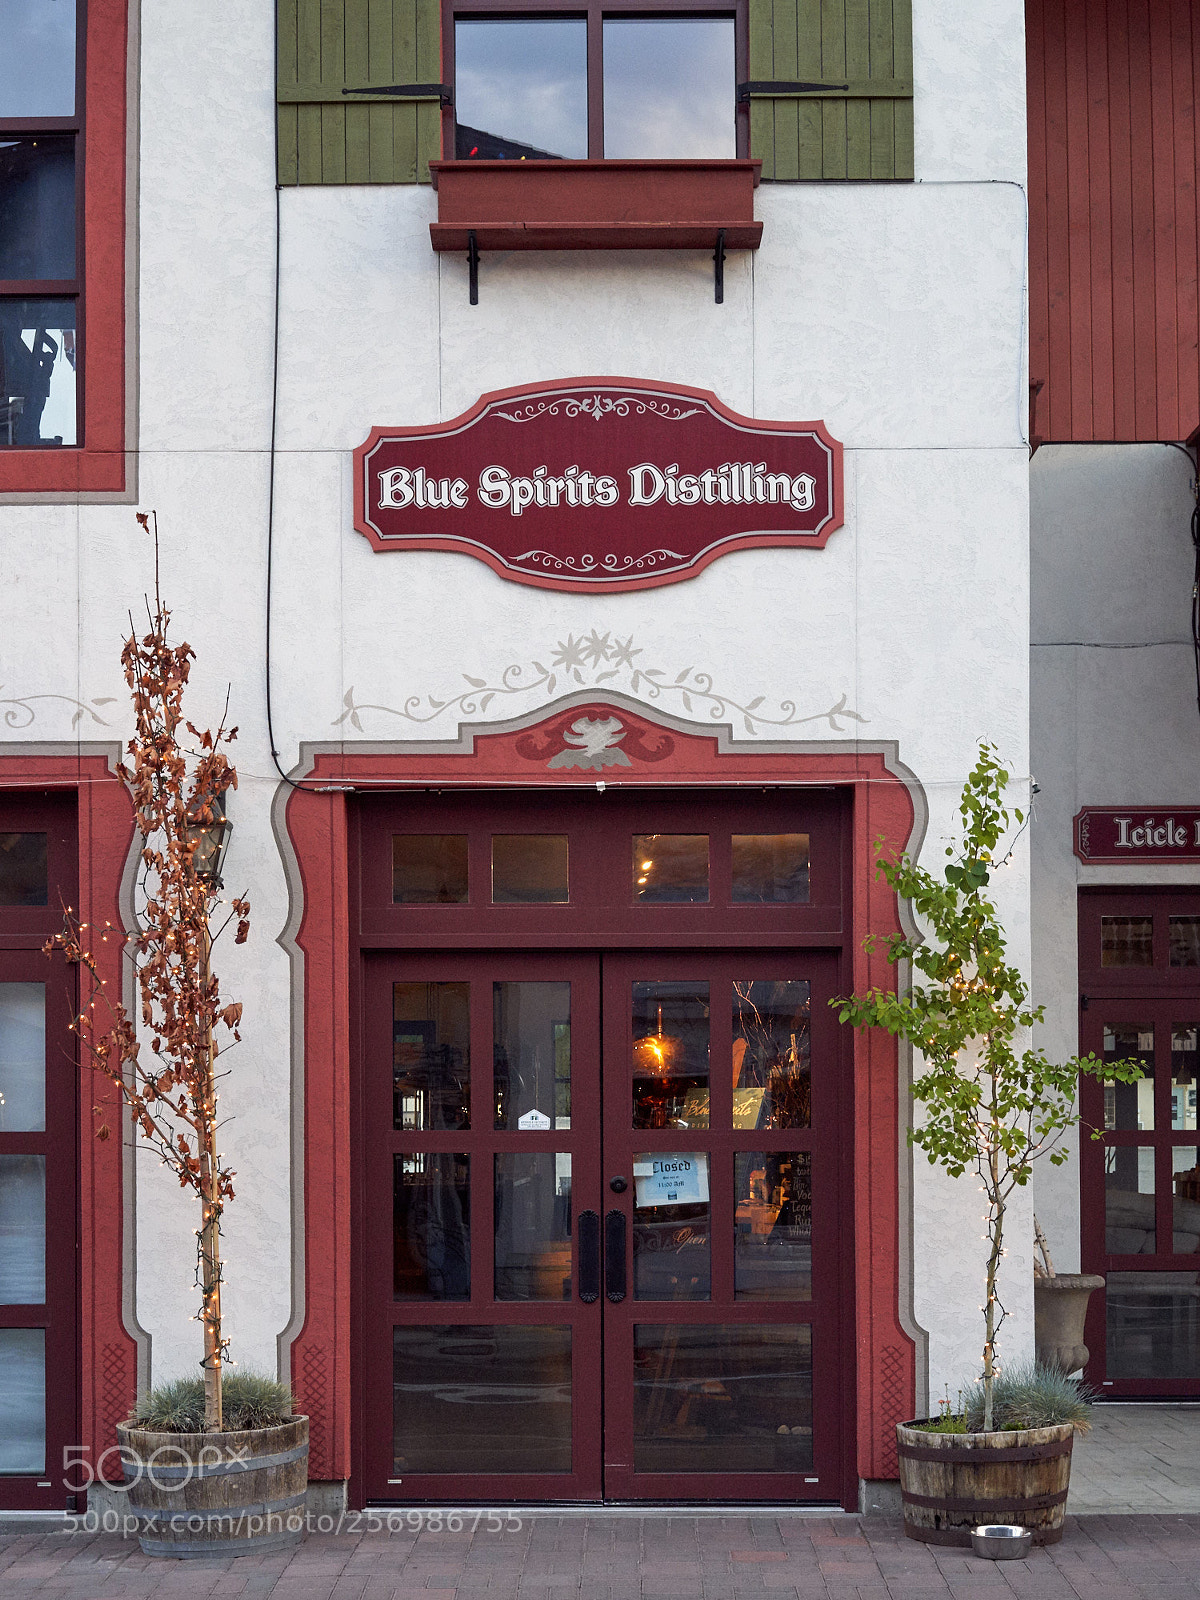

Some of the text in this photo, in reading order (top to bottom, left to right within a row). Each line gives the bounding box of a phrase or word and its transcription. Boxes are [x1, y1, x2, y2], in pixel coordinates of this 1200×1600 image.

[378, 462, 816, 517] Blue Spirits Distilling
[1113, 817, 1187, 847] Icicle
[653, 1160, 691, 1173] Closed
